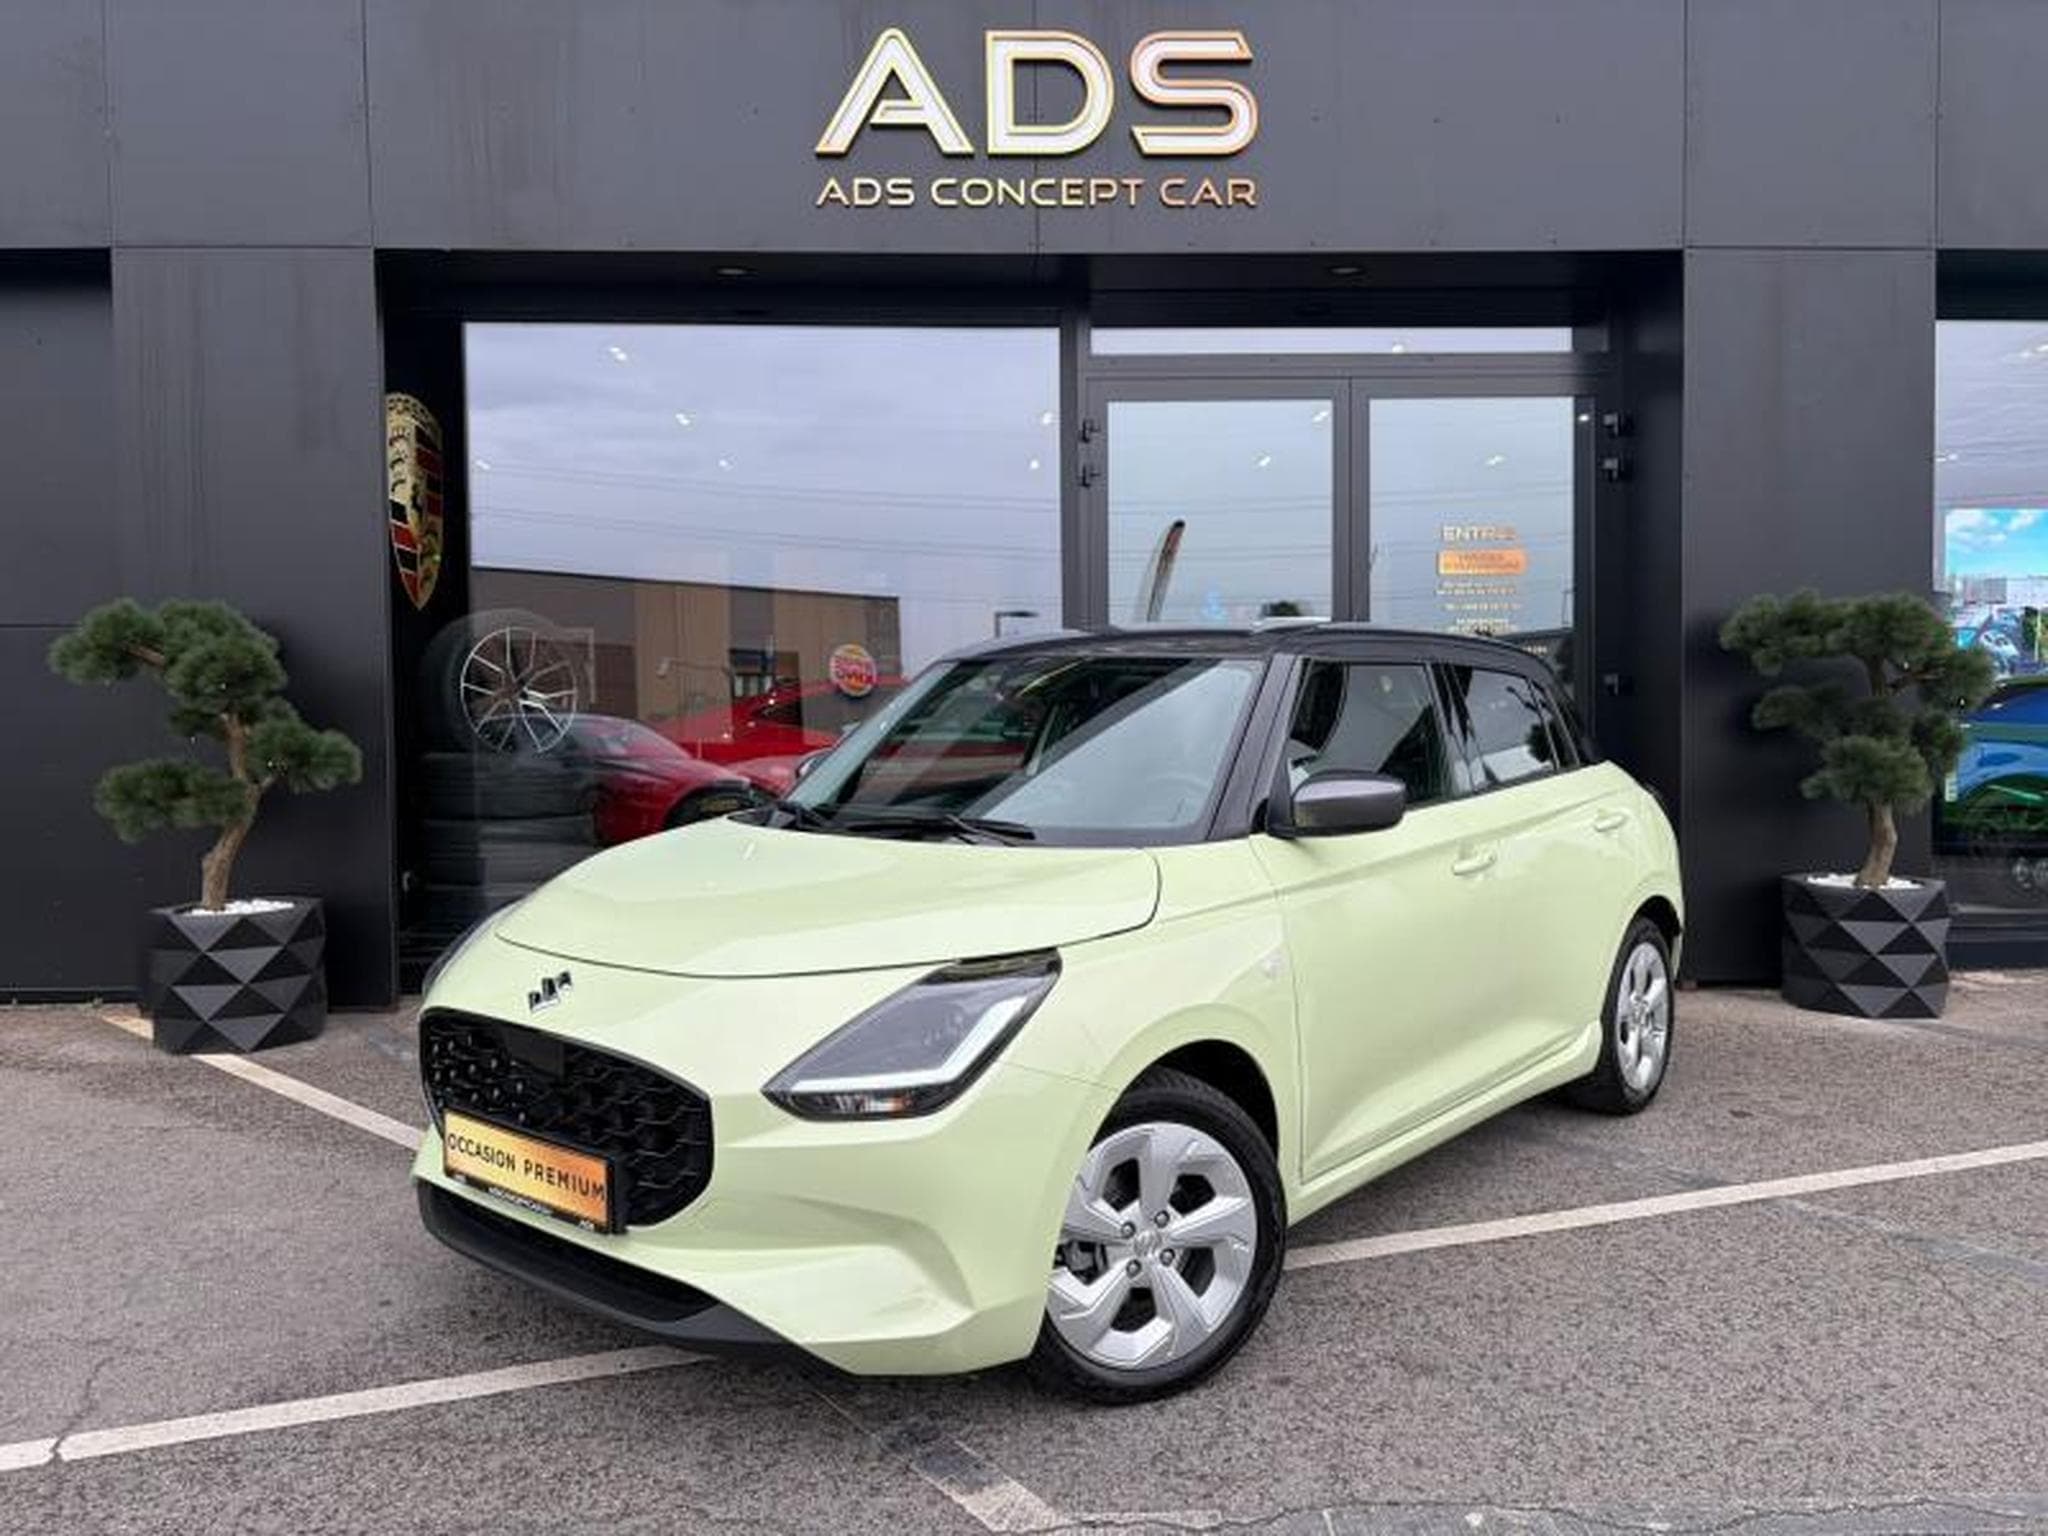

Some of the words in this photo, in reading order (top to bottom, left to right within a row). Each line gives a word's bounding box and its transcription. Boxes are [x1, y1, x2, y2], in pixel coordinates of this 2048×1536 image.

[815, 27, 1259, 156] ADS
[816, 177, 915, 207] ADS
[931, 177, 1144, 207] CONCEPT
[1160, 177, 1258, 207] CAR
[447, 1133, 516, 1172] OCCASION
[524, 1159, 606, 1201] PREMIUM
